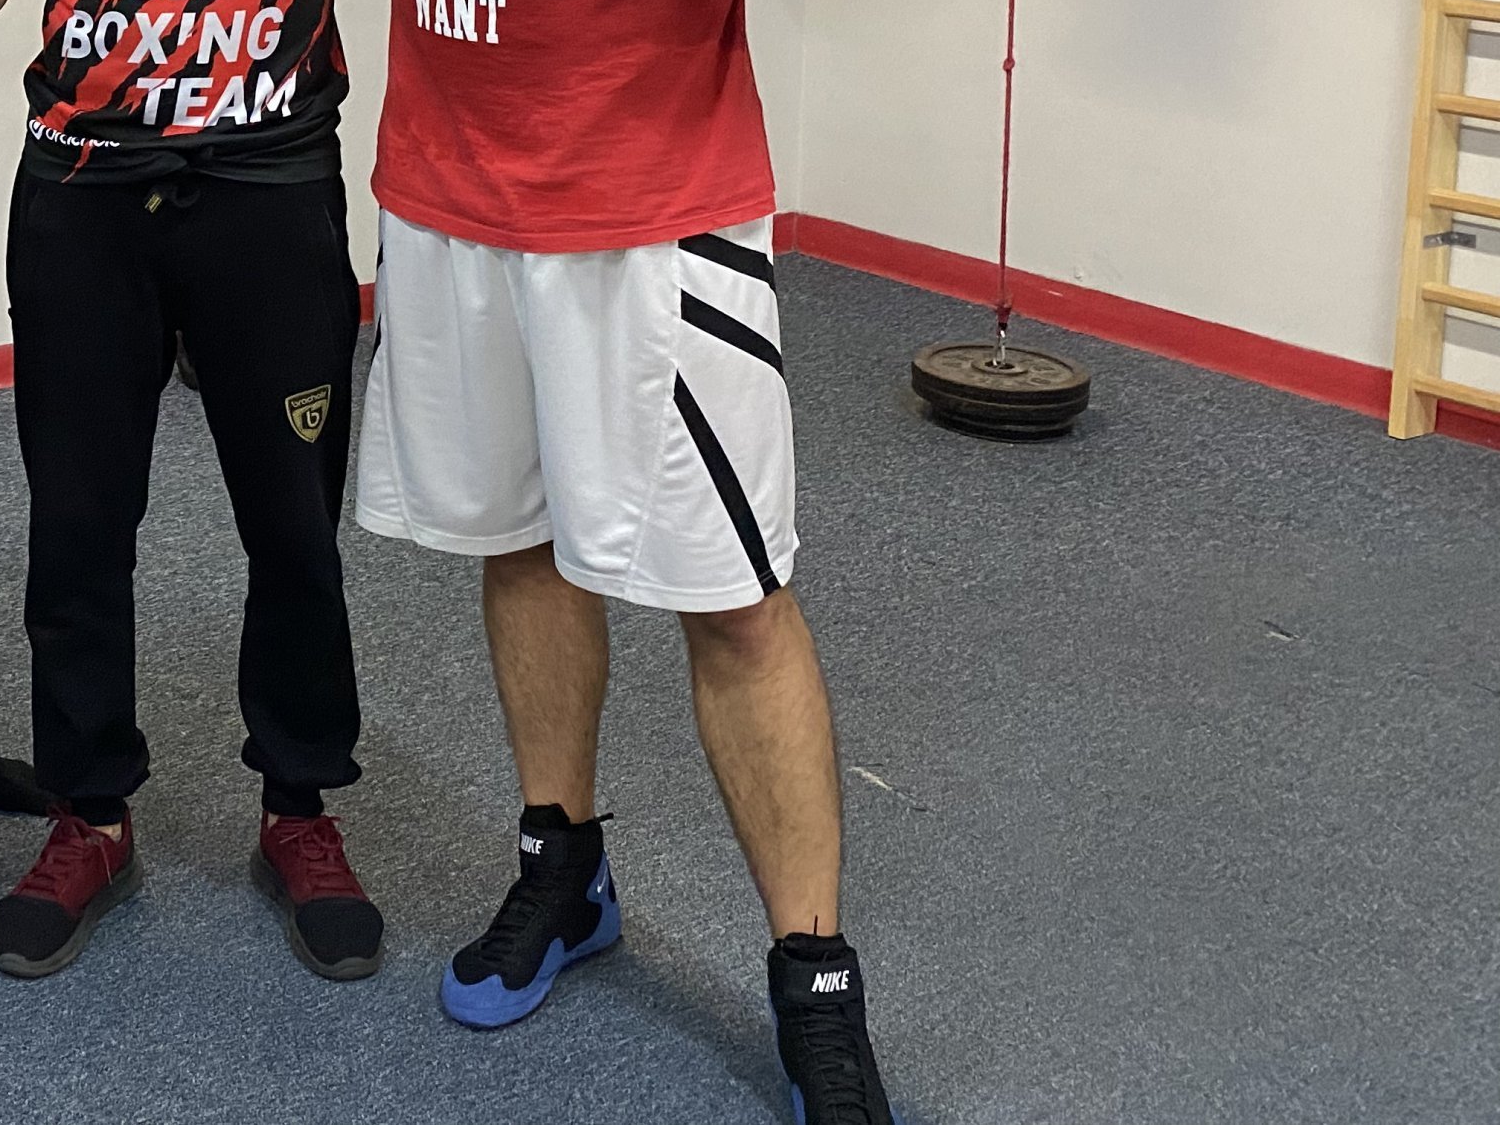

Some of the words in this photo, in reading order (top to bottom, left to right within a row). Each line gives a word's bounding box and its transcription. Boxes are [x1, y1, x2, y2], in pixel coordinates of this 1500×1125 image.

[62, 6, 284, 65] BOXING
[136, 71, 297, 127] TEAM
[811, 970, 850, 993] NIKE
